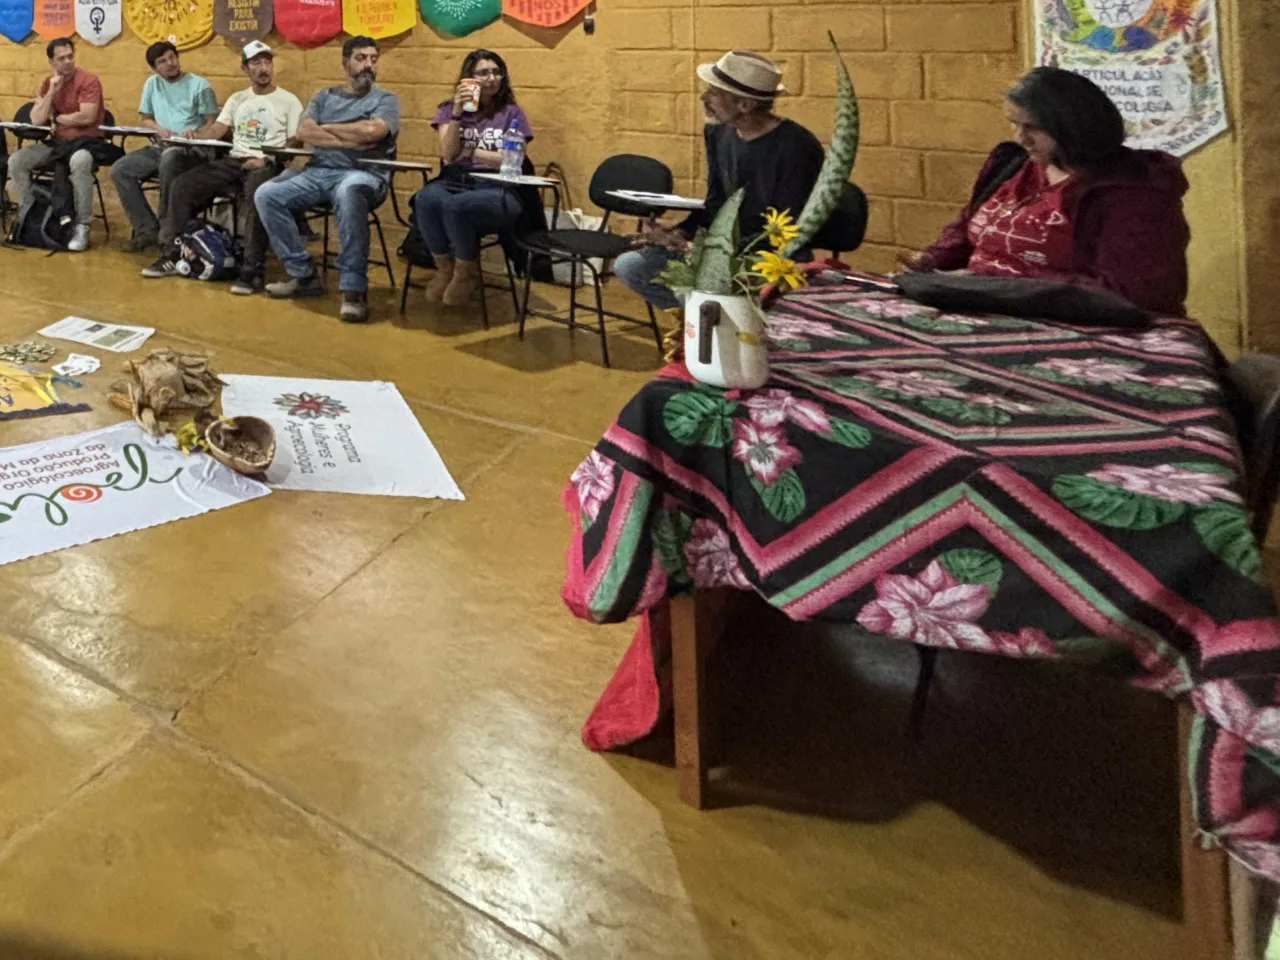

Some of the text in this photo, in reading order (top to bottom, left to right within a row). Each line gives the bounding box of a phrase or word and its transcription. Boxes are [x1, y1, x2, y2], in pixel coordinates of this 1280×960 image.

[229, 20, 258, 32] EXISTIR
[87, 443, 106, 452] da
[283, 419, 317, 474] Agroecologia
[308, 421, 337, 469] Mulheres e
[334, 423, 361, 463] Programa
[18, 456, 41, 467] da
[33, 452, 112, 473] Produção
[42, 448, 84, 461] Zona
[3, 459, 120, 491] Agroecológico
